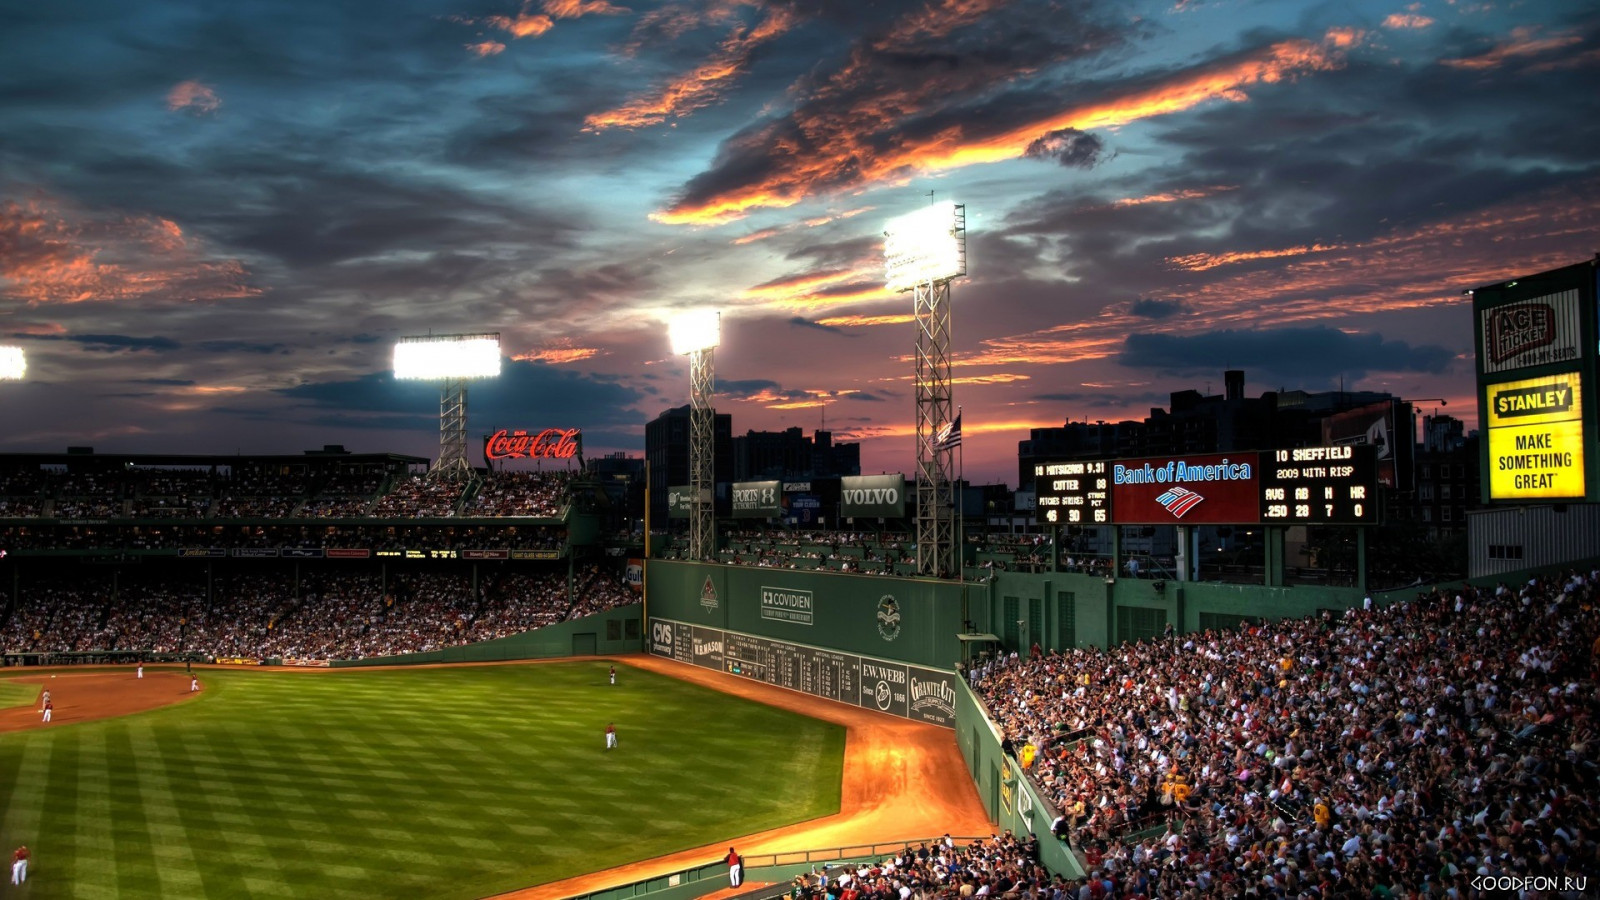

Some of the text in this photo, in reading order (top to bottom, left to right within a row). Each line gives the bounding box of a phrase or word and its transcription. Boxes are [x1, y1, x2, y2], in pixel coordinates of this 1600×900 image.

[1501, 310, 1546, 333] ACE
[1501, 327, 1546, 352] TICKET
[1498, 389, 1567, 413] STANLEY
[1515, 433, 1552, 450] MAKE
[1276, 446, 1352, 462] 10 SHEFFIELD
[1499, 452, 1572, 470] SOMETHING
[1087, 462, 1105, 474] 9.31
[1113, 458, 1251, 484] Bank of America
[1276, 466, 1354, 479] 2009 WITH RISP
[1053, 480, 1079, 490] CUTTER
[1514, 473, 1554, 489] GREAT
[842, 488, 898, 505] VOLVO
[1265, 486, 1365, 500] AVG AB H HR
[1264, 504, 1363, 517] .250 28 7 0
[773, 593, 810, 609] COVIDIEN
[653, 622, 672, 645] CVS
[879, 667, 905, 684] WEBB
[862, 685, 874, 696] Since
